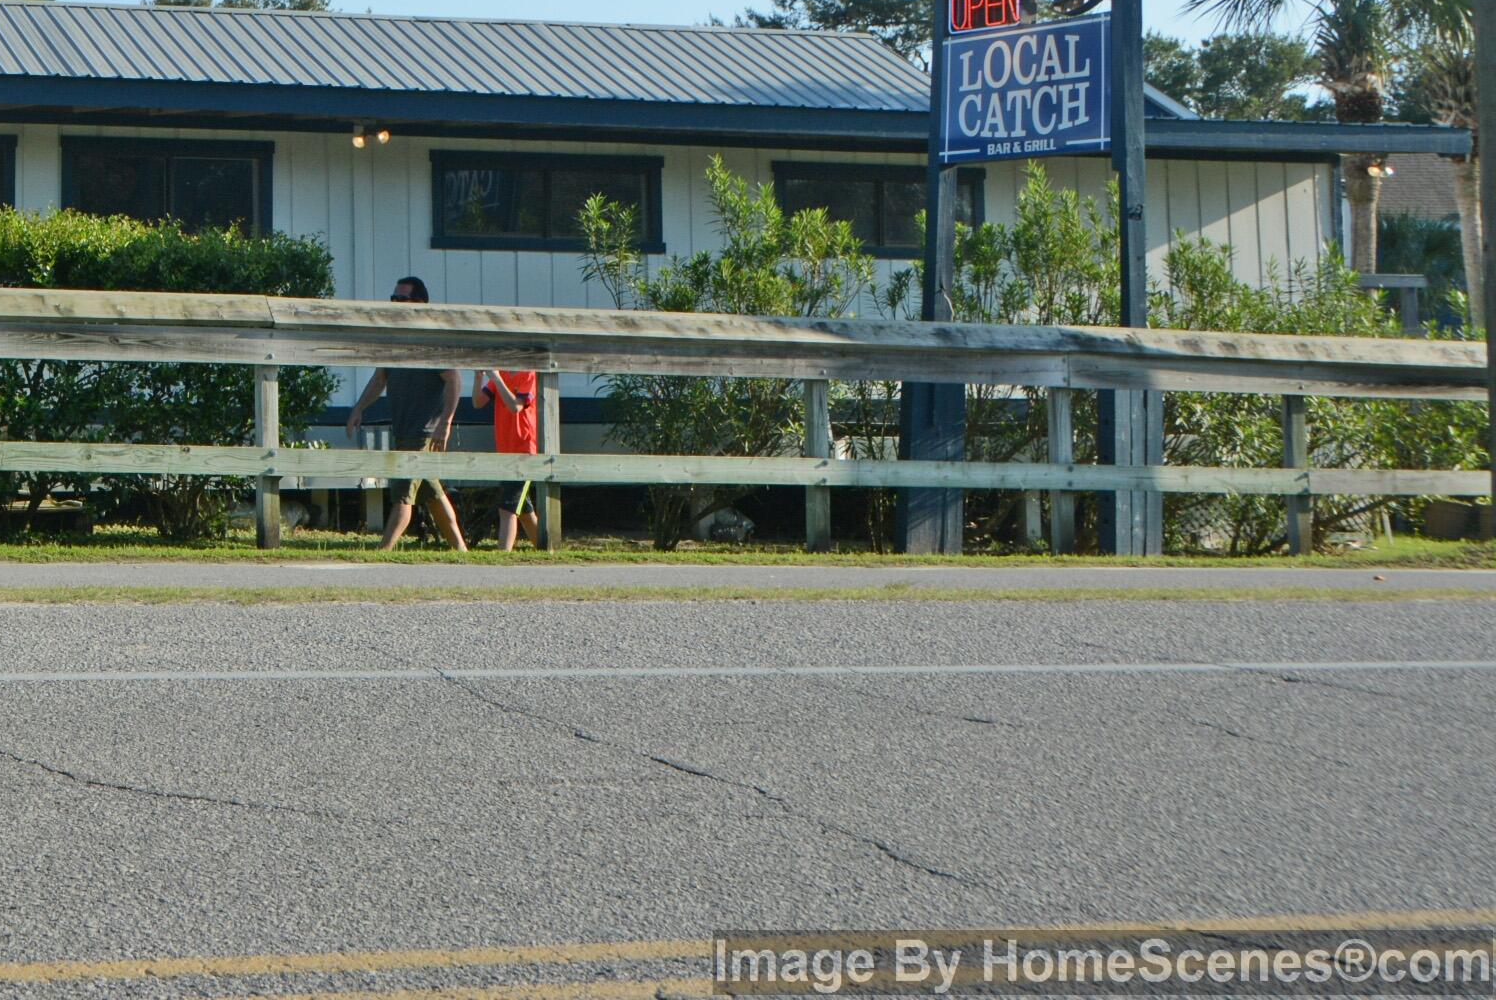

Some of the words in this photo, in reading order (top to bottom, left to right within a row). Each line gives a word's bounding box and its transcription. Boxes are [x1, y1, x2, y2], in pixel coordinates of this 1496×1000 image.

[958, 34, 1090, 92] LOCAL
[958, 82, 1090, 138] CATCH
[987, 142, 1011, 155] BAR
[1012, 141, 1022, 153] &
[1024, 138, 1057, 152] GRILL
